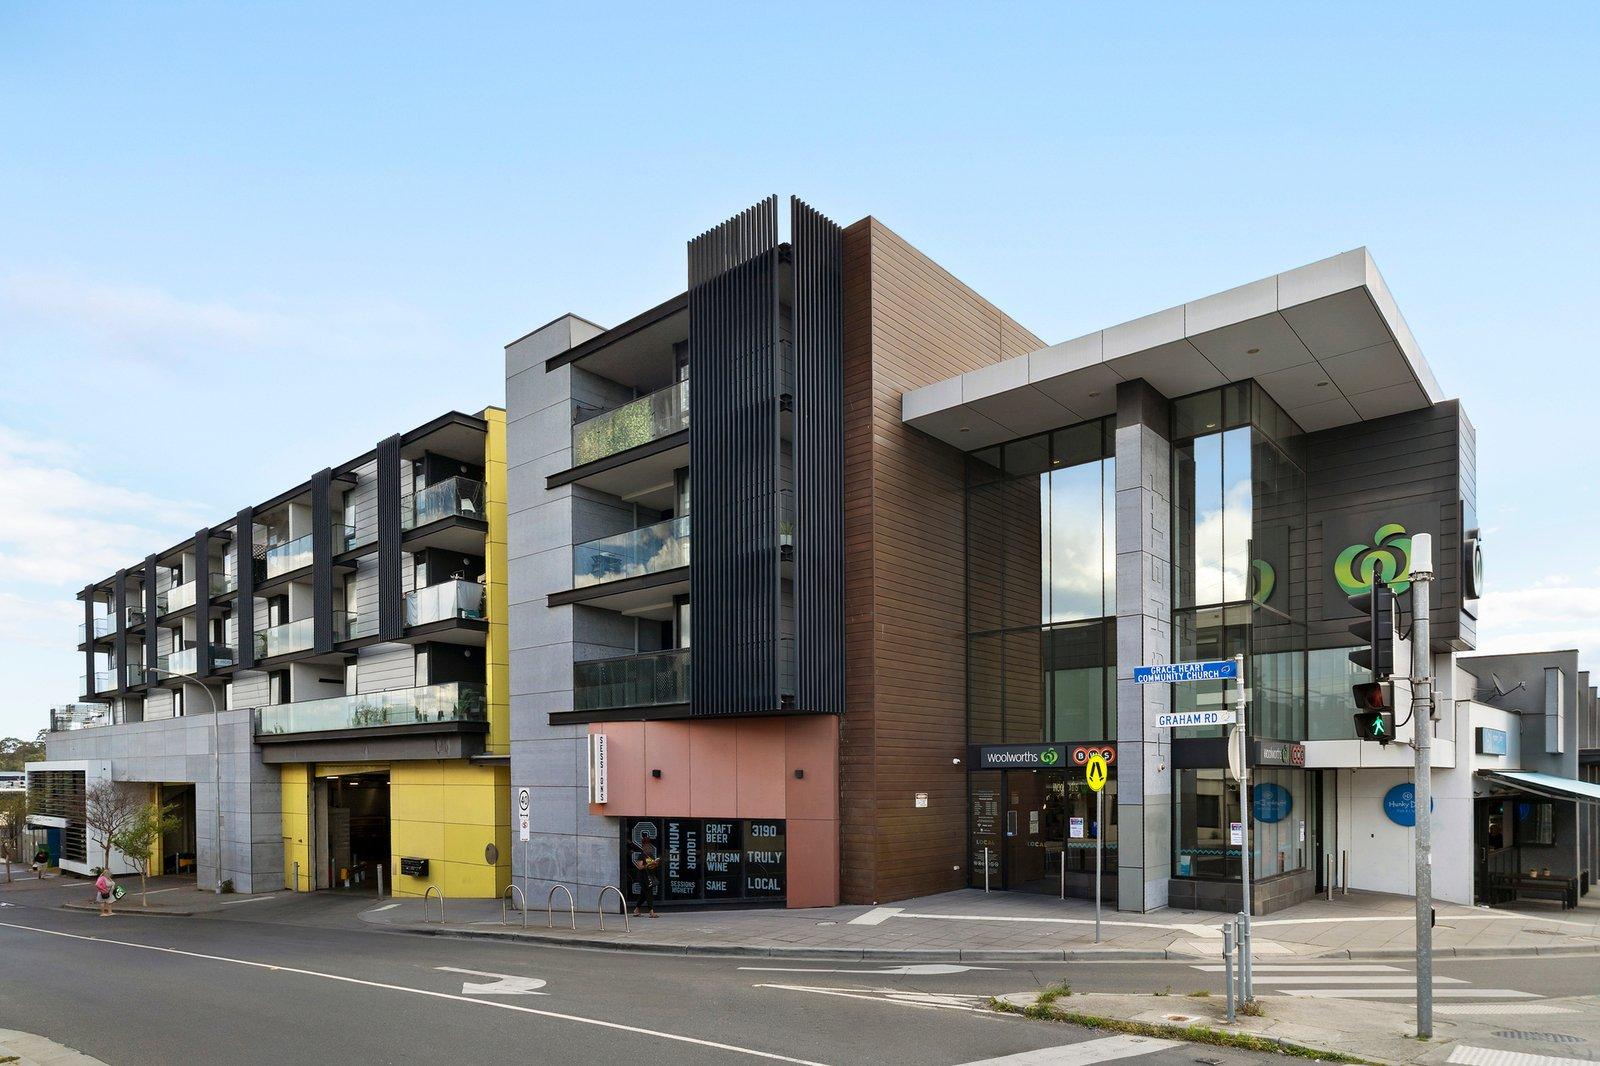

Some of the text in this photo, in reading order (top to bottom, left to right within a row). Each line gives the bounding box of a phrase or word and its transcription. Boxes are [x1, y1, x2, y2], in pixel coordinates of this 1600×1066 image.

[1151, 664, 1205, 675] GRACE HEART
[1138, 670, 1219, 683] COMMUNITY CHURCH
[1159, 713, 1218, 726] GRAHAM RD
[987, 751, 1039, 763] woolworths
[1388, 800, 1410, 810] Hunky
[705, 824, 732, 834] CRAFT
[751, 825, 777, 837] 3190
[706, 833, 728, 843] BEER
[669, 822, 680, 878] PREMIUM
[686, 831, 697, 870] LIQUOR
[706, 852, 740, 863] ARTISAN
[747, 851, 782, 864] TRULY
[706, 862, 729, 872] WINE
[706, 880, 727, 891] SAKE
[747, 877, 781, 890] LOCAL
